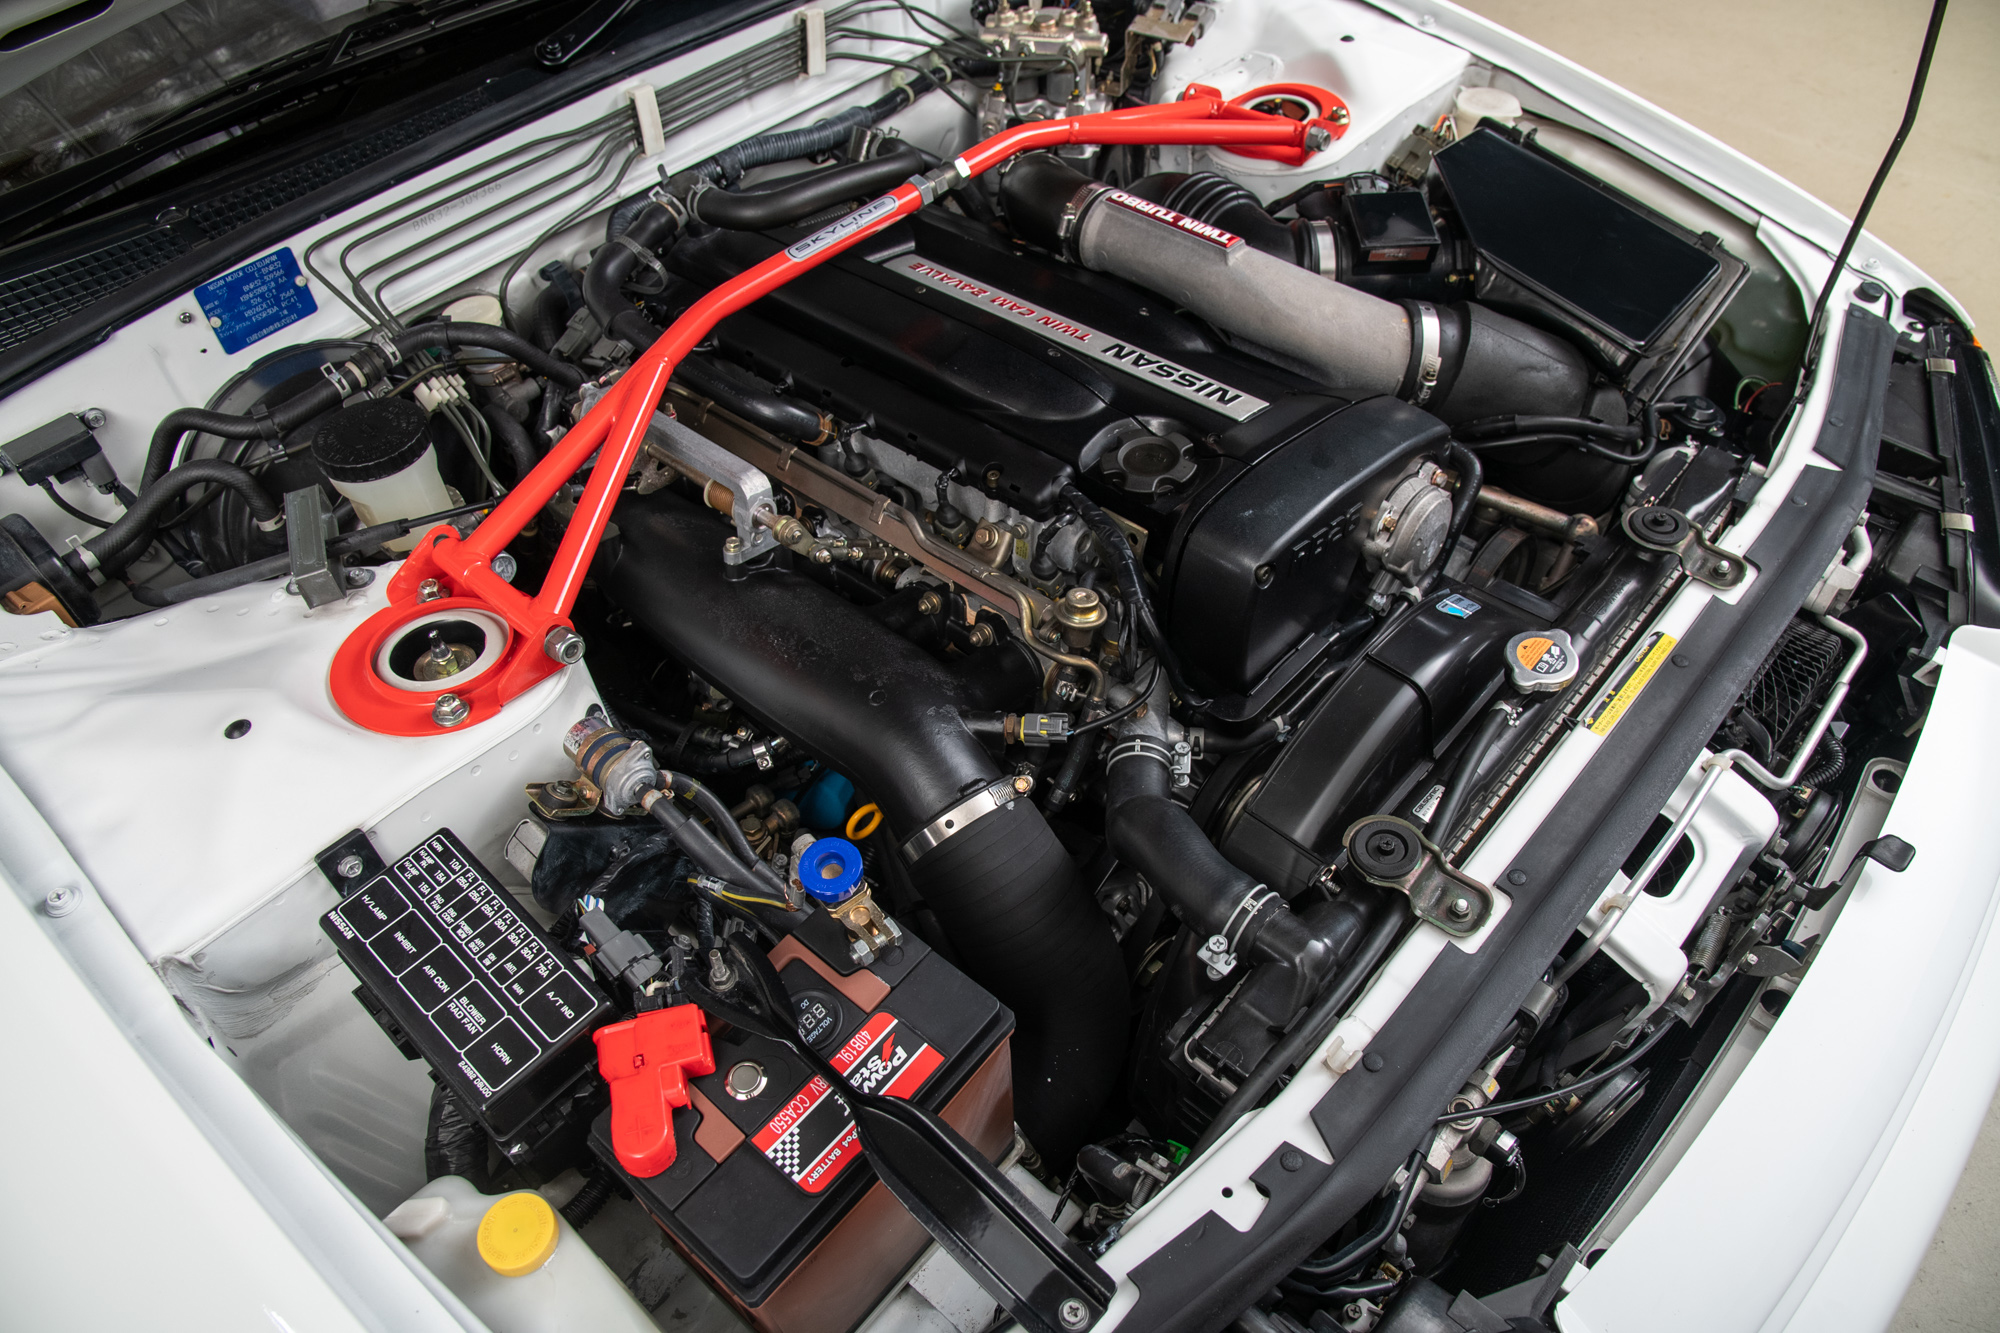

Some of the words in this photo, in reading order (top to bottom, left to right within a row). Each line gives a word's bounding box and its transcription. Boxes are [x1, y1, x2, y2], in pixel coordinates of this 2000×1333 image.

[1111, 192, 1178, 222] TURBO
[795, 201, 886, 253] SKYLINE
[1177, 216, 1233, 244] TWIN
[207, 279, 225, 292] NISSAN
[225, 271, 244, 283] MOTOR
[909, 262, 990, 298] 24VALVE
[990, 295, 1038, 319] CAM
[1036, 315, 1092, 343] TWIN
[1101, 343, 1245, 406] NISSAN
[419, 849, 435, 865] H/LAMP
[433, 870, 447, 883] 15A
[430, 840, 444, 853] HORN
[449, 858, 462, 872] 10A
[403, 860, 420, 876] H/LAMP
[418, 881, 431, 895] 15A
[455, 876, 470, 890] 25A
[465, 871, 475, 883] FL
[433, 893, 445, 905] RAD
[468, 890, 482, 904] 25A
[477, 885, 488, 896] FL
[361, 894, 388, 920] H/LAMP
[429, 900, 441, 911] FAN
[480, 903, 495, 918] 25A
[490, 899, 501, 910] FL
[327, 910, 355, 940] NISSAN
[441, 912, 454, 925] CONT
[458, 920, 474, 935] POWER
[493, 918, 508, 932] 30A
[502, 912, 513, 924] FL
[393, 931, 417, 954] INHIBIT
[507, 932, 522, 947] 30A
[515, 927, 527, 939] FL
[520, 946, 535, 961] 30A
[528, 941, 540, 953] FL
[535, 963, 550, 978] 75A
[543, 957, 555, 970] FL
[422, 965, 437, 978] AIR
[433, 976, 450, 993] CON
[512, 982, 525, 995] MAIN
[459, 996, 487, 1025] BLOWER
[546, 991, 564, 1006] A/T
[560, 1004, 575, 1019] IND
[800, 999, 810, 1009] DC
[447, 1002, 463, 1019] RAD
[461, 1017, 478, 1035] FAN
[806, 1016, 833, 1043] VOLTAGE
[490, 1042, 513, 1066] HORN
[835, 1030, 872, 1065] 40B19L
[769, 1094, 810, 1134] CCA550
[806, 1147, 842, 1185] BATTERY
